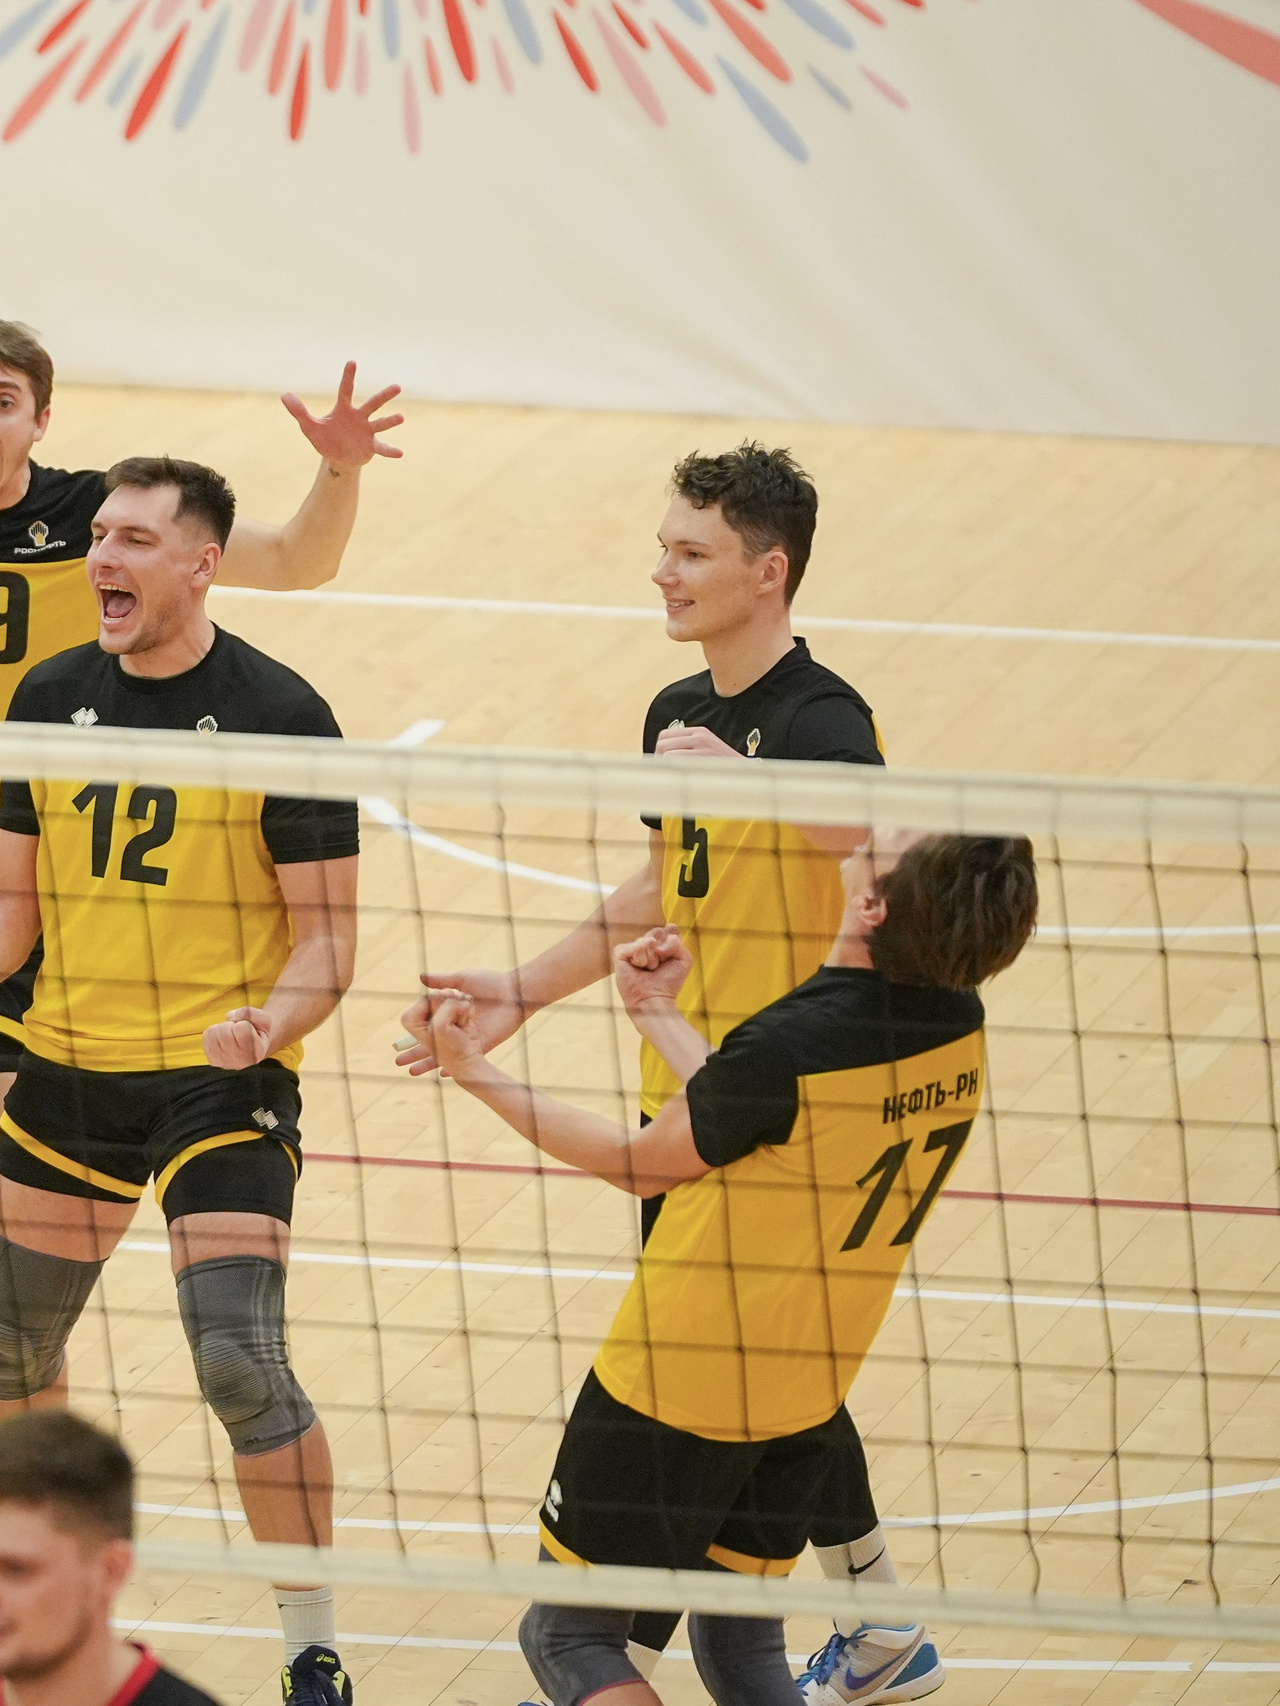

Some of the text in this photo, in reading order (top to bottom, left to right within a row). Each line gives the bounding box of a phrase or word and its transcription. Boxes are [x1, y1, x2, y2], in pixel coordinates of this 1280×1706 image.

[15, 540, 67, 554] РОСНФТЬ
[71, 781, 178, 887] 12
[677, 808, 710, 899] 5
[882, 1068, 979, 1124] НЕФТЬ-РН
[839, 1117, 975, 1253] 17
